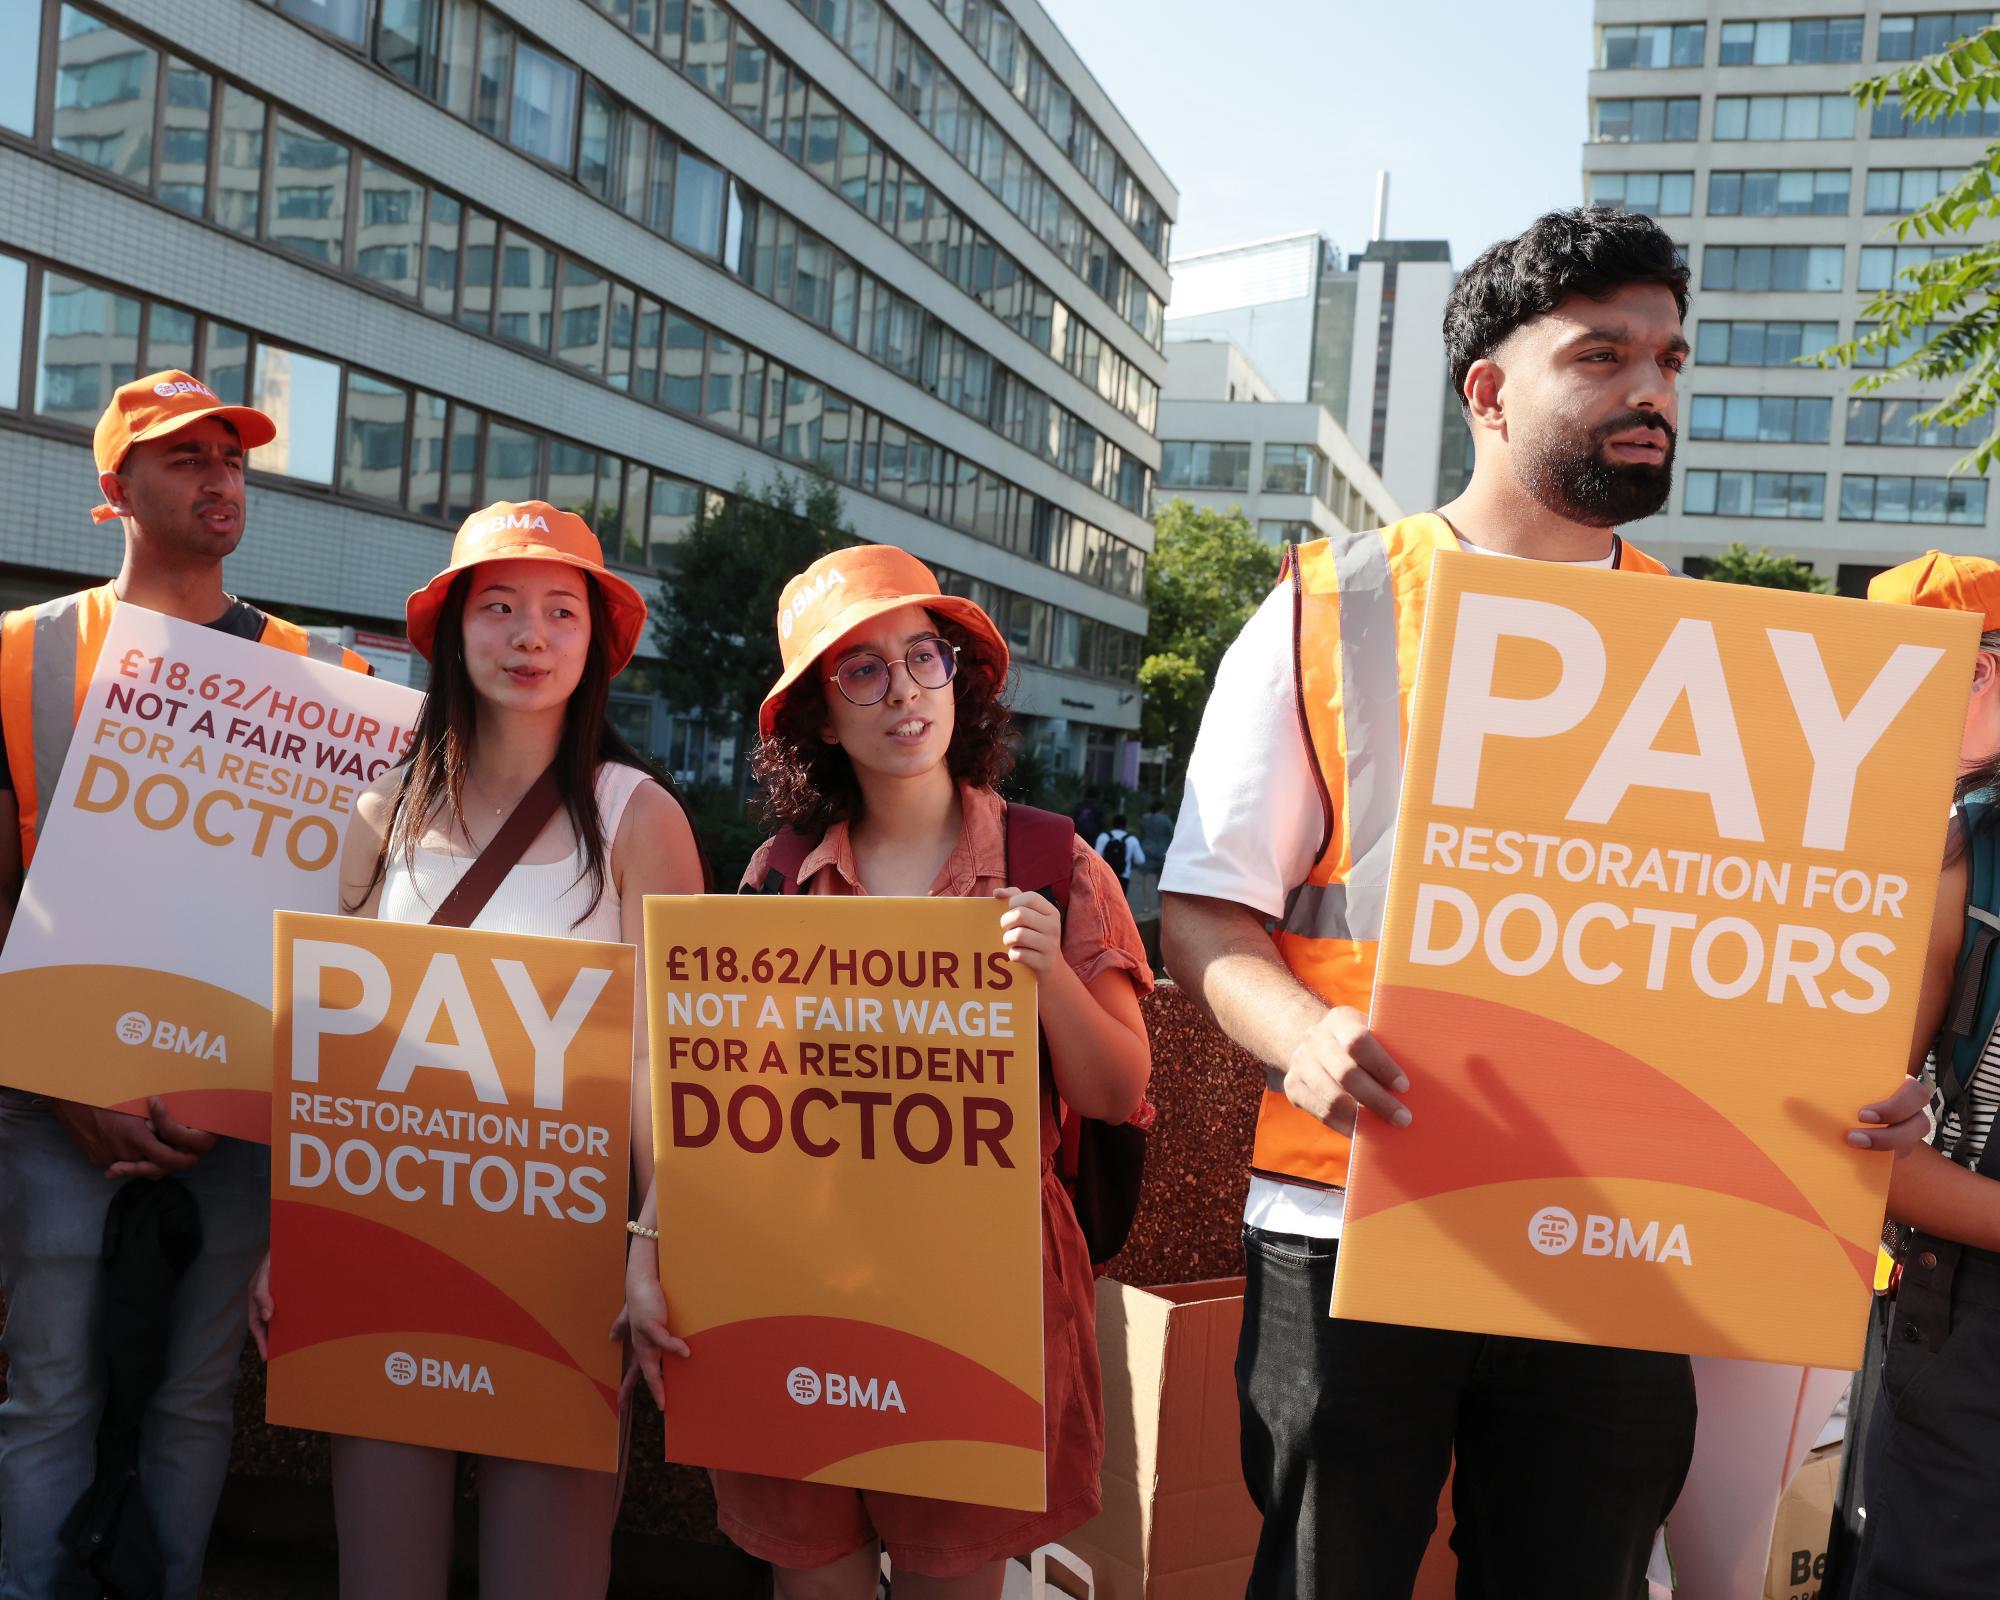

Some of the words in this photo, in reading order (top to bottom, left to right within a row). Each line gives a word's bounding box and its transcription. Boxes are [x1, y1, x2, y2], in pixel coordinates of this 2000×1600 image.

[491, 513, 550, 533] BMA
[792, 568, 847, 618] BMA
[105, 683, 188, 727] NOT
[189, 710, 215, 739] A
[226, 717, 307, 764] FAIR
[119, 648, 380, 748] £18.62/HOUR
[1431, 591, 1947, 851] PAY
[94, 718, 174, 764] FOR
[179, 745, 206, 775] A
[217, 753, 354, 815] RESIDE
[73, 754, 339, 872] DOCTO
[1422, 821, 1791, 905] RESTORATION
[1803, 865, 1908, 919] FOR
[666, 943, 960, 989] £18.62/HOUR
[973, 950, 1014, 991] IS
[1409, 882, 1897, 1014] DOCTORS
[152, 1020, 227, 1065] BMA
[291, 938, 614, 1111] PAY
[667, 992, 747, 1028] NOT
[756, 995, 785, 1031] A
[795, 996, 884, 1034] FAIR
[893, 999, 1015, 1038] WAGE
[669, 1036, 748, 1073] FOR
[758, 1041, 788, 1075] A
[799, 1042, 1015, 1085] RESIDENT
[290, 1091, 529, 1149] RESTORATION
[539, 1120, 609, 1158] FOR
[671, 1082, 1016, 1169] DOCTOR
[289, 1132, 608, 1224] DOCTORS
[1582, 1214, 1693, 1266] BMA
[421, 1357, 495, 1396] BMA
[825, 1372, 907, 1414] BMA
